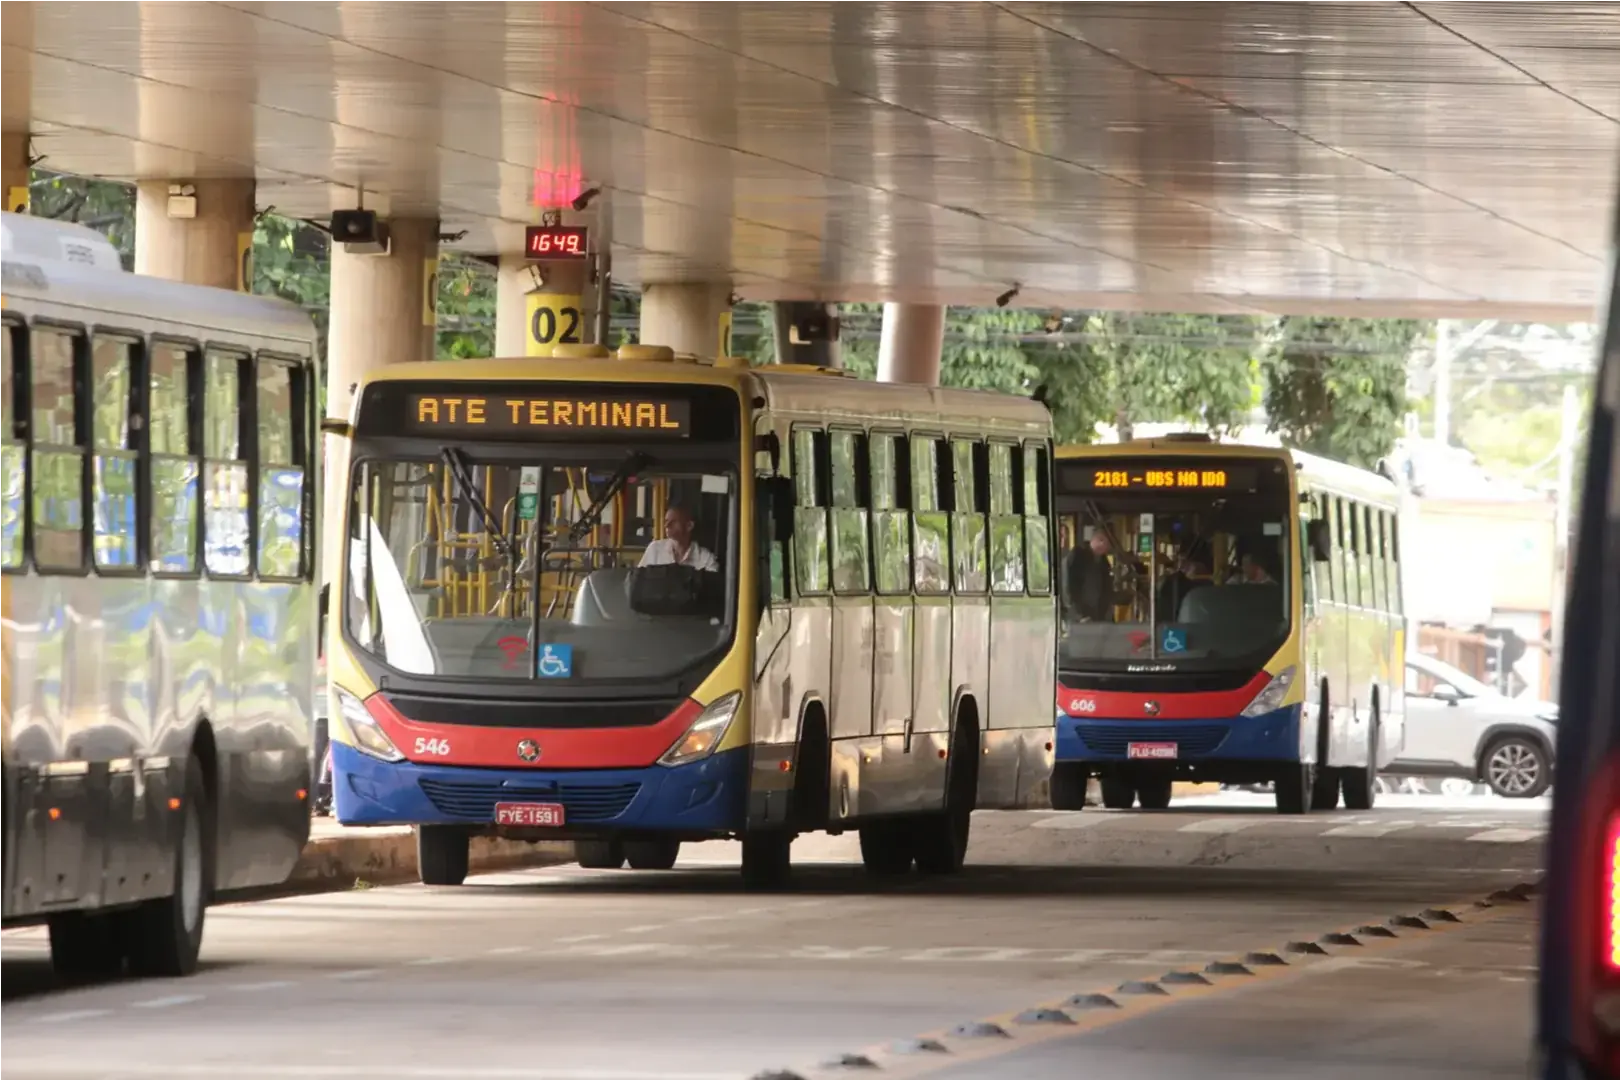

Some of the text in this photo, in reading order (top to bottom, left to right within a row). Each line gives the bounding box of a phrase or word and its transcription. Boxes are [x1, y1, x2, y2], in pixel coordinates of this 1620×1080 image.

[531, 306, 580, 344] 02
[418, 398, 679, 428] ATE TERMINAL
[1145, 471, 1174, 487] UBS
[1070, 699, 1096, 713] 606
[414, 737, 450, 755] 546
